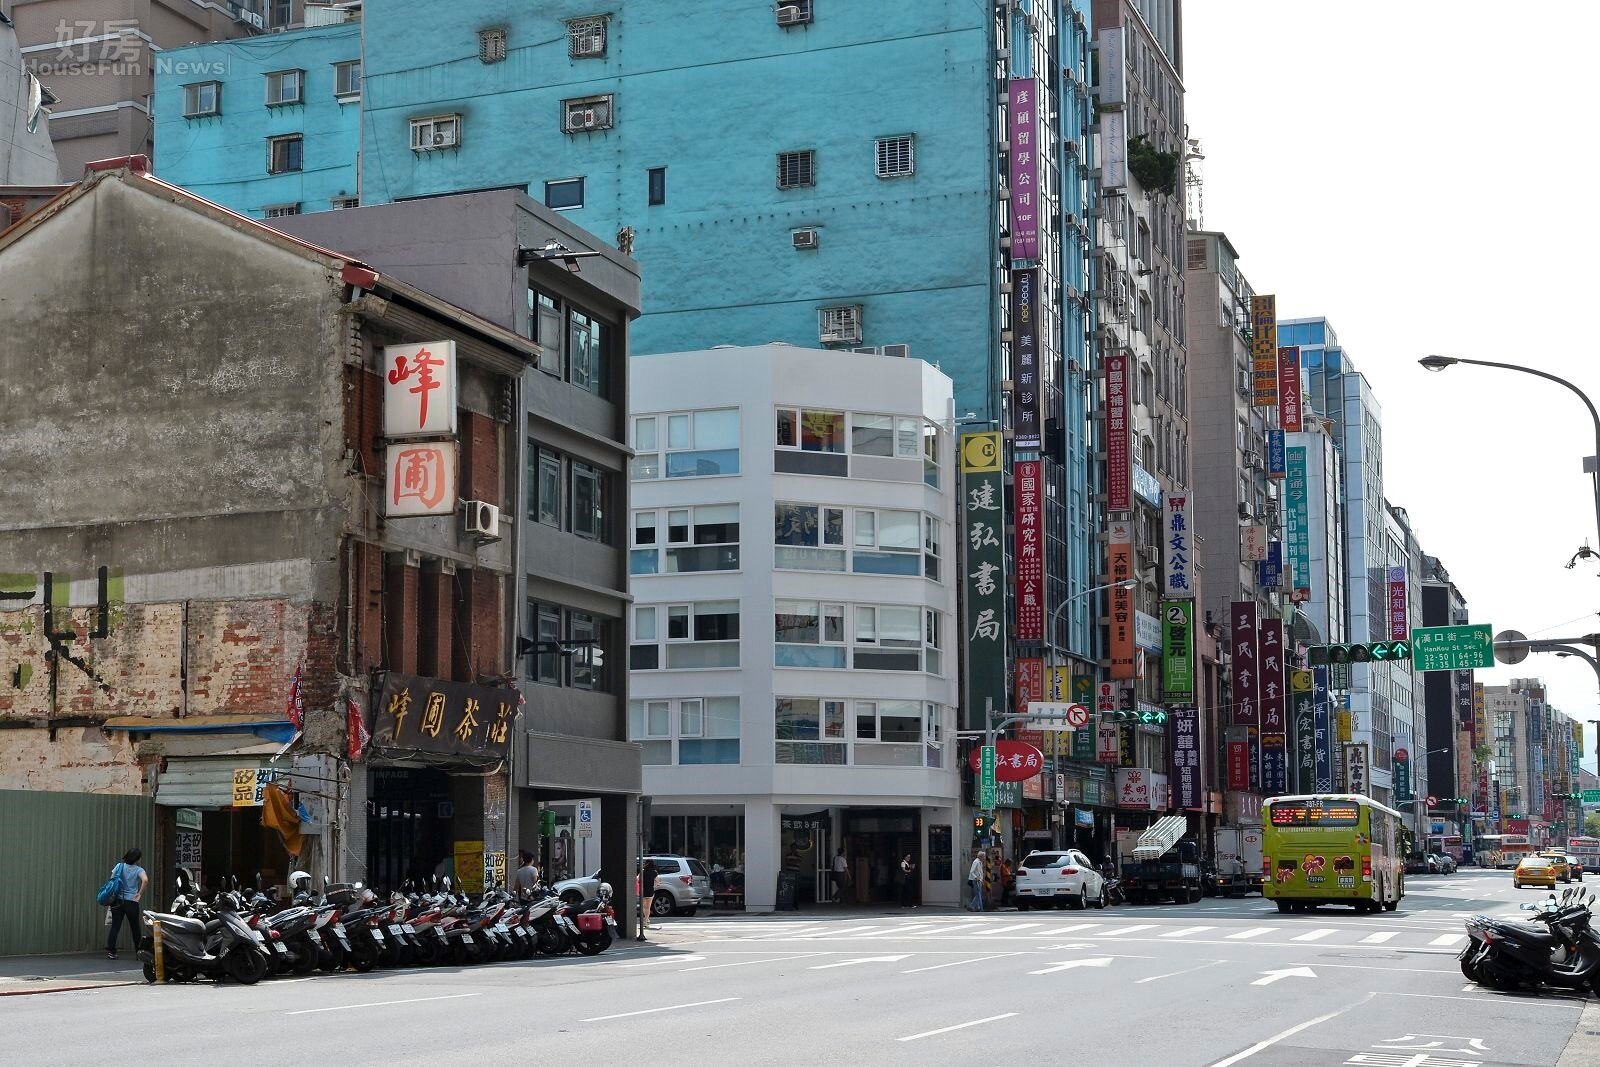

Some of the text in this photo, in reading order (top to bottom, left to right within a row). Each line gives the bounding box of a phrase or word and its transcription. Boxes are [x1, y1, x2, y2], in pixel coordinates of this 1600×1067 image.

[1109, 370, 1124, 430] 國家補習班
[1022, 478, 1036, 505] 國家
[1022, 513, 1036, 557] 研究所
[1169, 513, 1189, 590] 鼎文公職
[967, 480, 1001, 642] 建弘書局
[1392, 586, 1405, 635] 光和證券
[1421, 631, 1484, 643] 漢口街一段
[1425, 652, 1483, 661] 32-50 64-96
[1237, 614, 1253, 716] 三民書局
[1264, 631, 1279, 726] 三民書局
[1425, 662, 1450, 670] 27-35
[1298, 697, 1314, 769] 建宏書局
[1123, 784, 1147, 795] 黎明
[976, 818, 984, 826] 33
